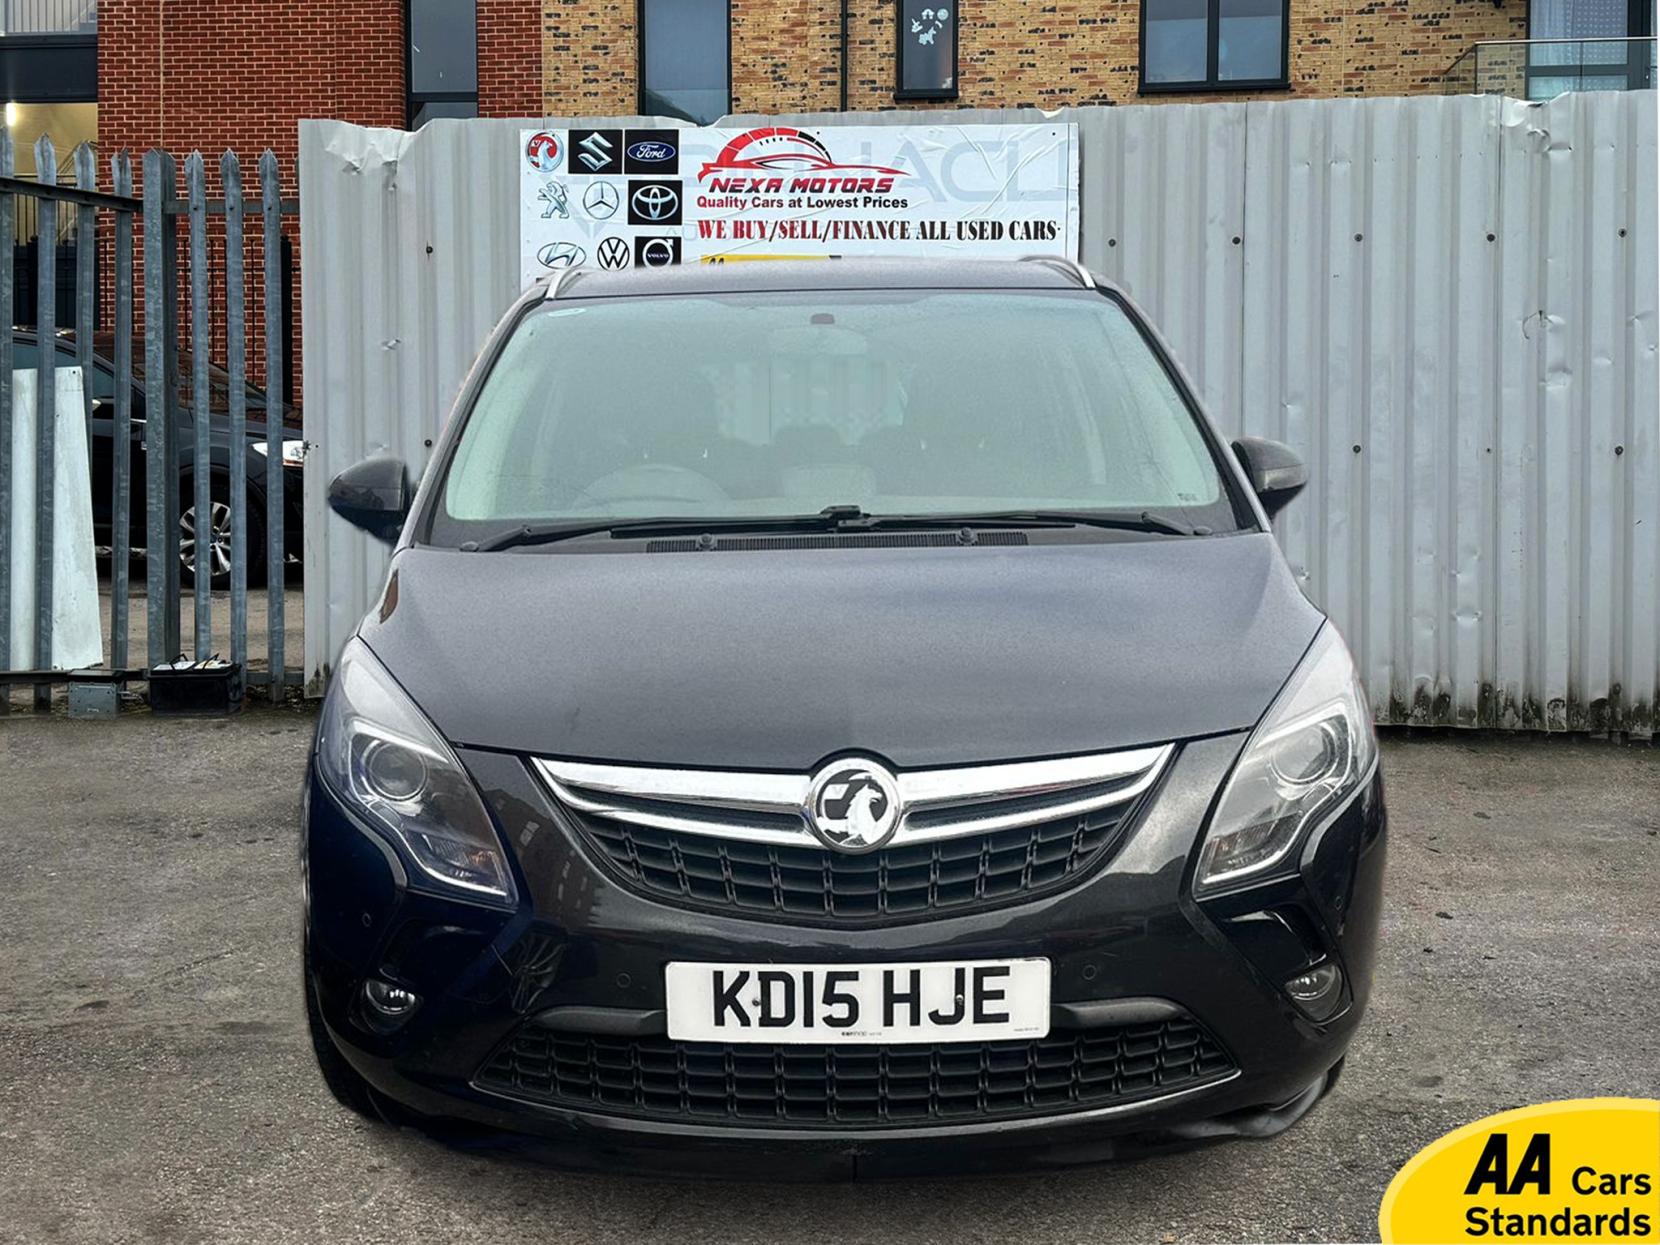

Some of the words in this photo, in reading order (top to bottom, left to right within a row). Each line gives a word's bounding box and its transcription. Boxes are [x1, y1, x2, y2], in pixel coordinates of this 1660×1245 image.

[636, 145, 666, 159] Ford
[708, 178, 784, 193] NEXA
[789, 178, 894, 193] MOTORS
[696, 196, 748, 211] Quality
[751, 196, 784, 208] Cars
[788, 197, 801, 208] at
[807, 196, 858, 208] Lowest
[863, 196, 908, 209] Prices
[697, 219, 727, 240] WE
[733, 219, 911, 242] BUY/SELL/FINANCE
[916, 220, 951, 240] ALL
[956, 220, 1004, 240] USED
[1008, 220, 1057, 240] CARS
[712, 970, 859, 1028] KD15
[883, 966, 1011, 1027] HJE
